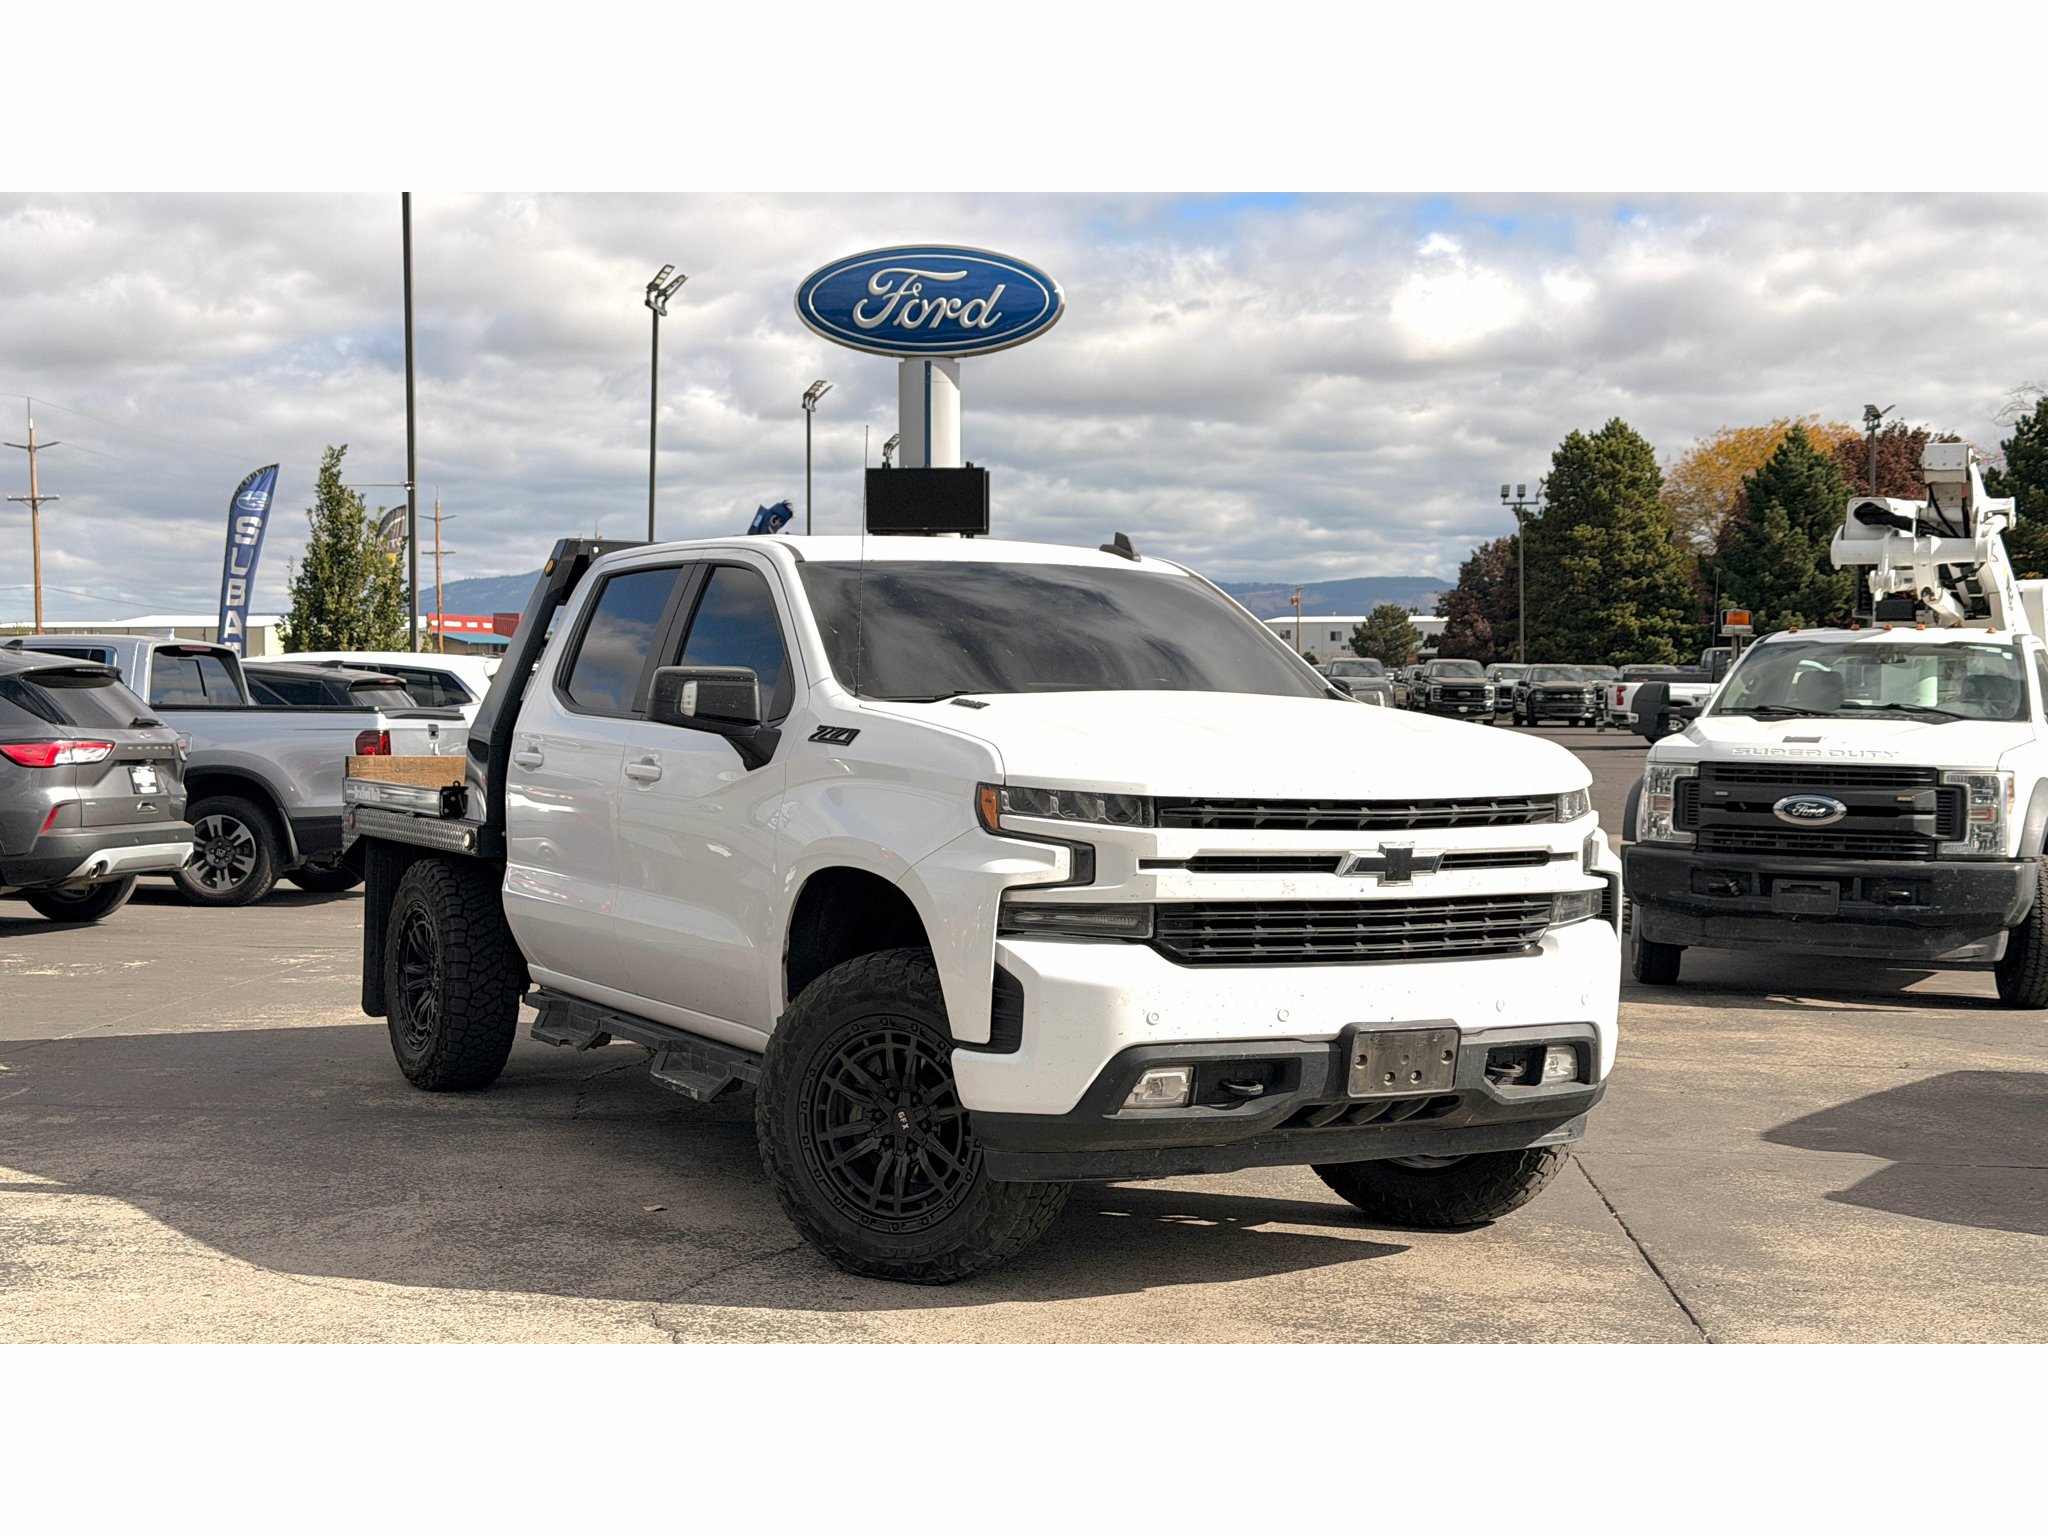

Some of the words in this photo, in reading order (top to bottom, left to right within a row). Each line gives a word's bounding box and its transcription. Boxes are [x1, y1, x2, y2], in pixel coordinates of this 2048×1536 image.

[853, 267, 1006, 329] Ford
[1732, 747, 1822, 757] SUPER
[1828, 749, 1900, 758] DUTY
[1792, 802, 1827, 817] Ford
[897, 1111, 910, 1130] GFX
